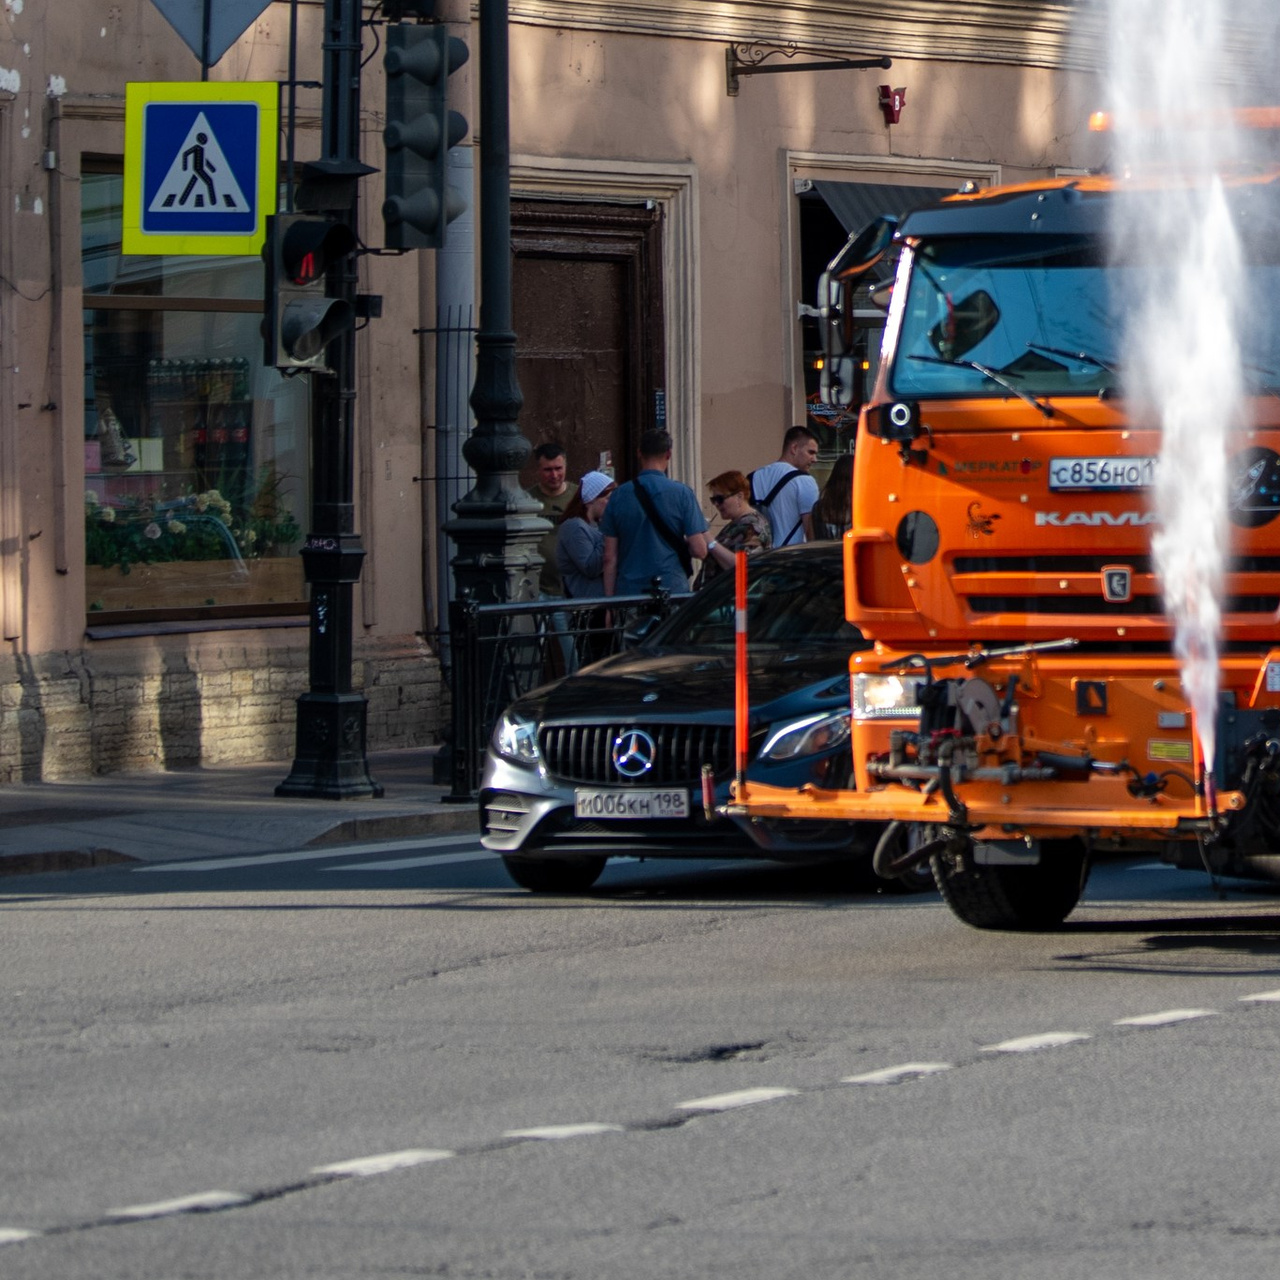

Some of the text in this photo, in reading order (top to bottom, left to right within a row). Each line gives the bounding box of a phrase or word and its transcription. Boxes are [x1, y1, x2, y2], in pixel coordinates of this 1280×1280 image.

[954, 460, 1042, 472] МЕРКАТР
[1034, 511, 1163, 526] KAMA
[654, 793, 682, 808] 198
